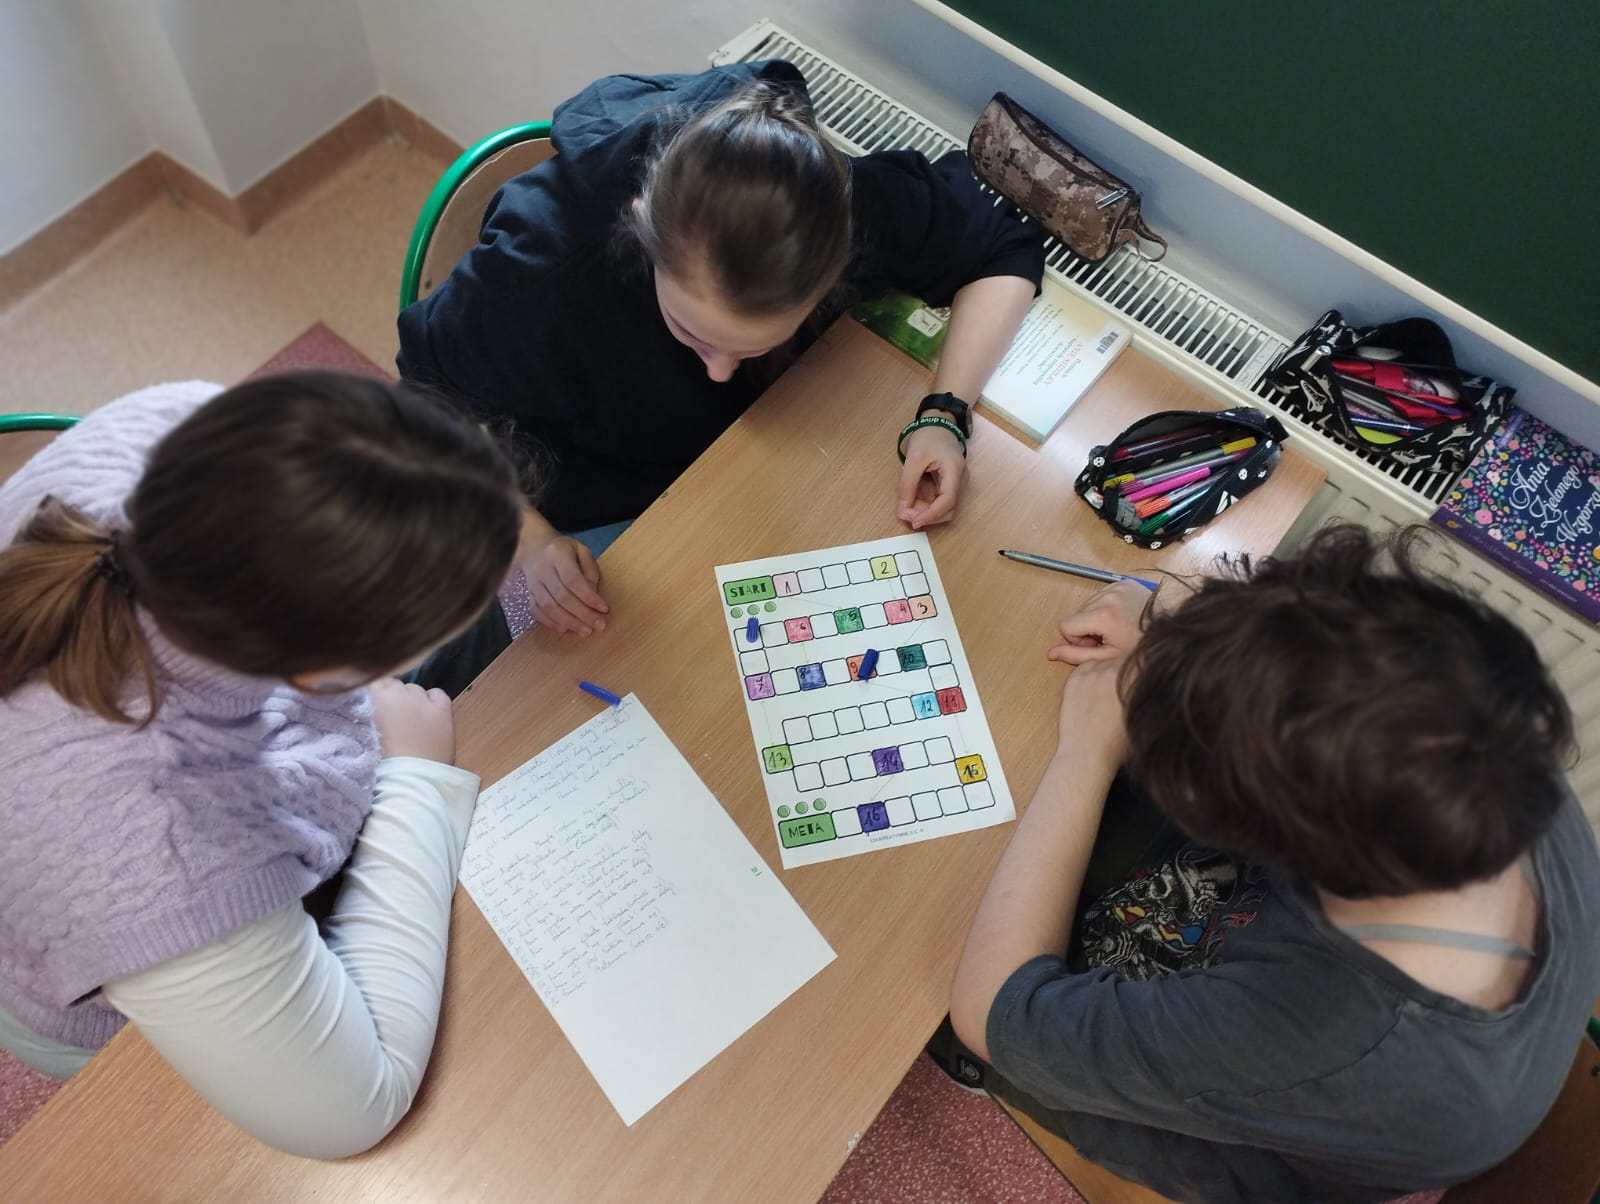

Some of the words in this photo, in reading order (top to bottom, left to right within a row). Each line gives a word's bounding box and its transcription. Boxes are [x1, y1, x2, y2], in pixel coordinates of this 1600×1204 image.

[1508, 462, 1550, 509] Ania
[1529, 465, 1582, 528] Zielonego
[880, 561, 890, 575] 2
[730, 583, 767, 598] START
[900, 604, 906, 613] 4
[917, 602, 928, 614] 3
[849, 661, 858, 675] 9
[755, 676, 765, 692] 7
[920, 701, 934, 714] 12
[768, 751, 788, 769] 13
[963, 765, 979, 779] 15
[787, 824, 825, 840] META
[863, 812, 881, 827] 16
